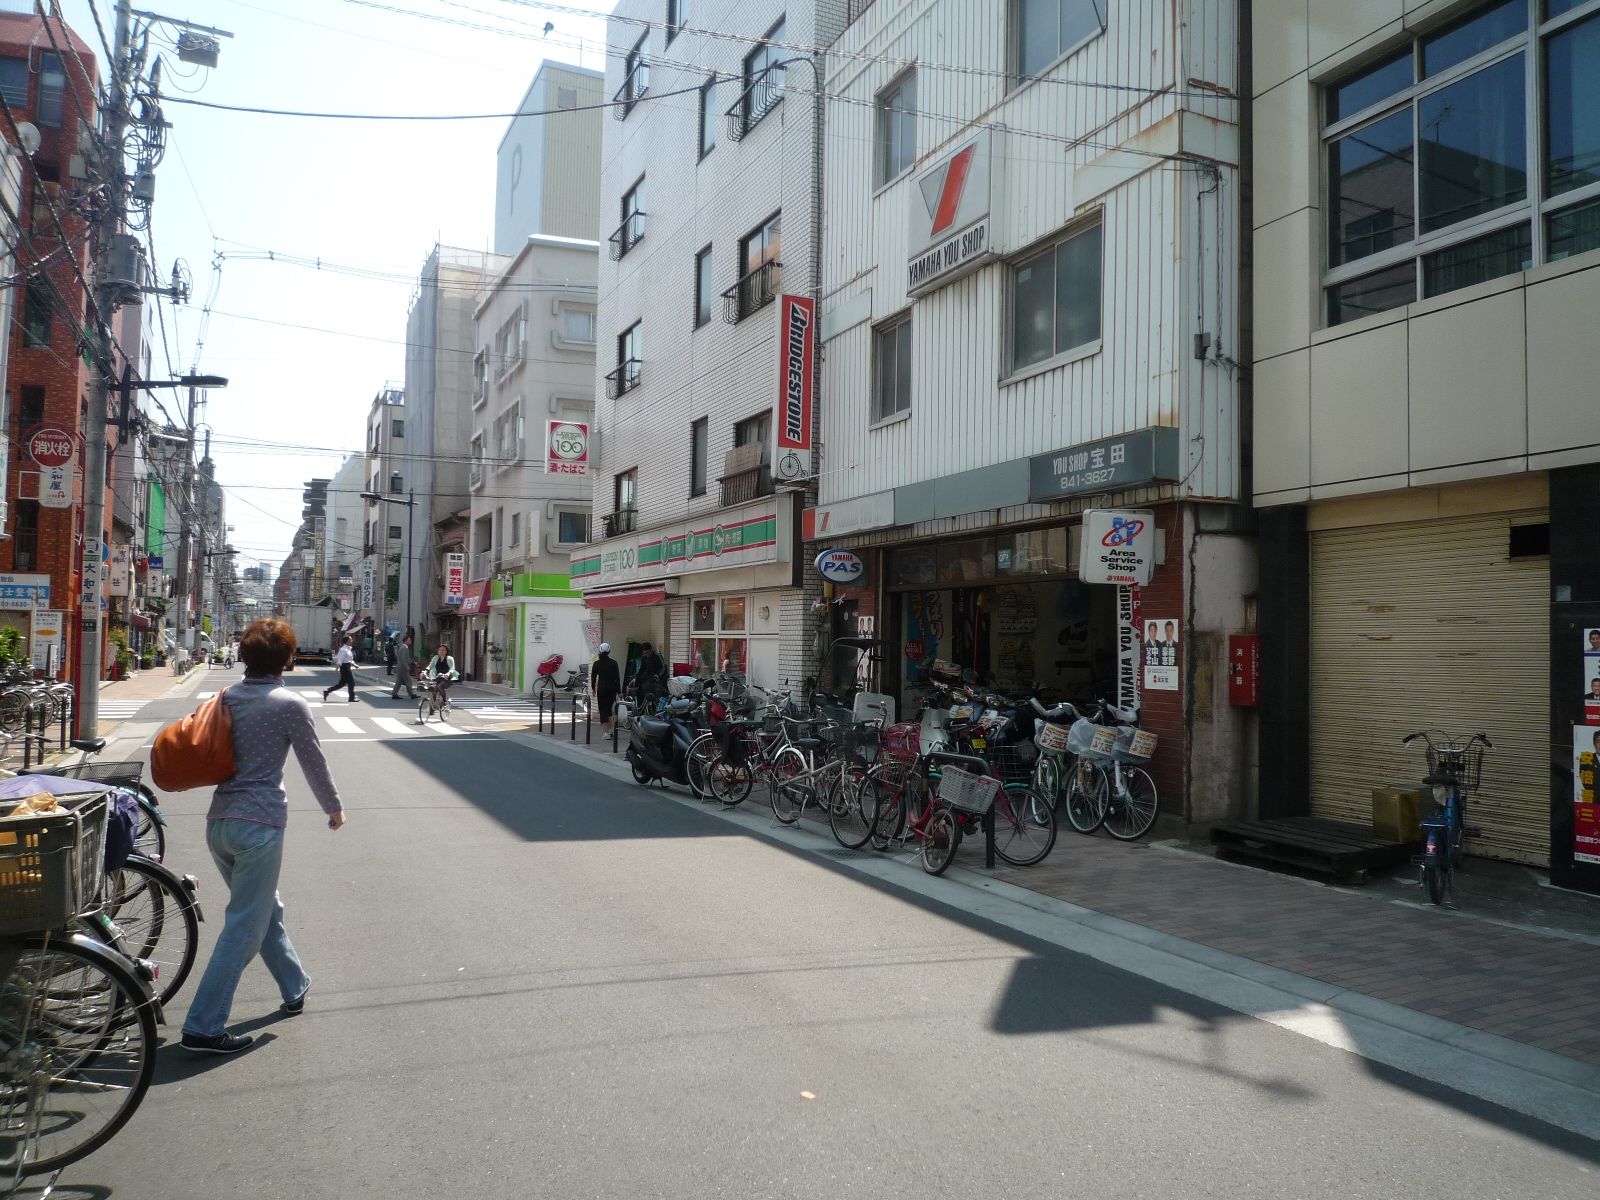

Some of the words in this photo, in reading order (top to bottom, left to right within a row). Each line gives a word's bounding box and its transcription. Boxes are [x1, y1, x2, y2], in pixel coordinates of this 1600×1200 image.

[909, 249, 941, 286] YAMAHA
[944, 238, 959, 267] YOU
[962, 225, 984, 258] SHOP
[787, 302, 810, 444] BRIDGESTONE
[34, 440, 71, 457] 消火栓
[556, 440, 583, 454] 100
[1053, 456, 1067, 475] YOU
[1068, 452, 1088, 472] SHOP
[1060, 467, 1116, 490] 841-3627
[831, 554, 853, 562] YAMAHA
[1100, 556, 1143, 565] Service
[1109, 549, 1136, 557] Area
[823, 561, 862, 573] PAS
[1107, 564, 1137, 573] Shop
[1120, 627, 1132, 653] YOU
[1152, 647, 1159, 666] 中山
